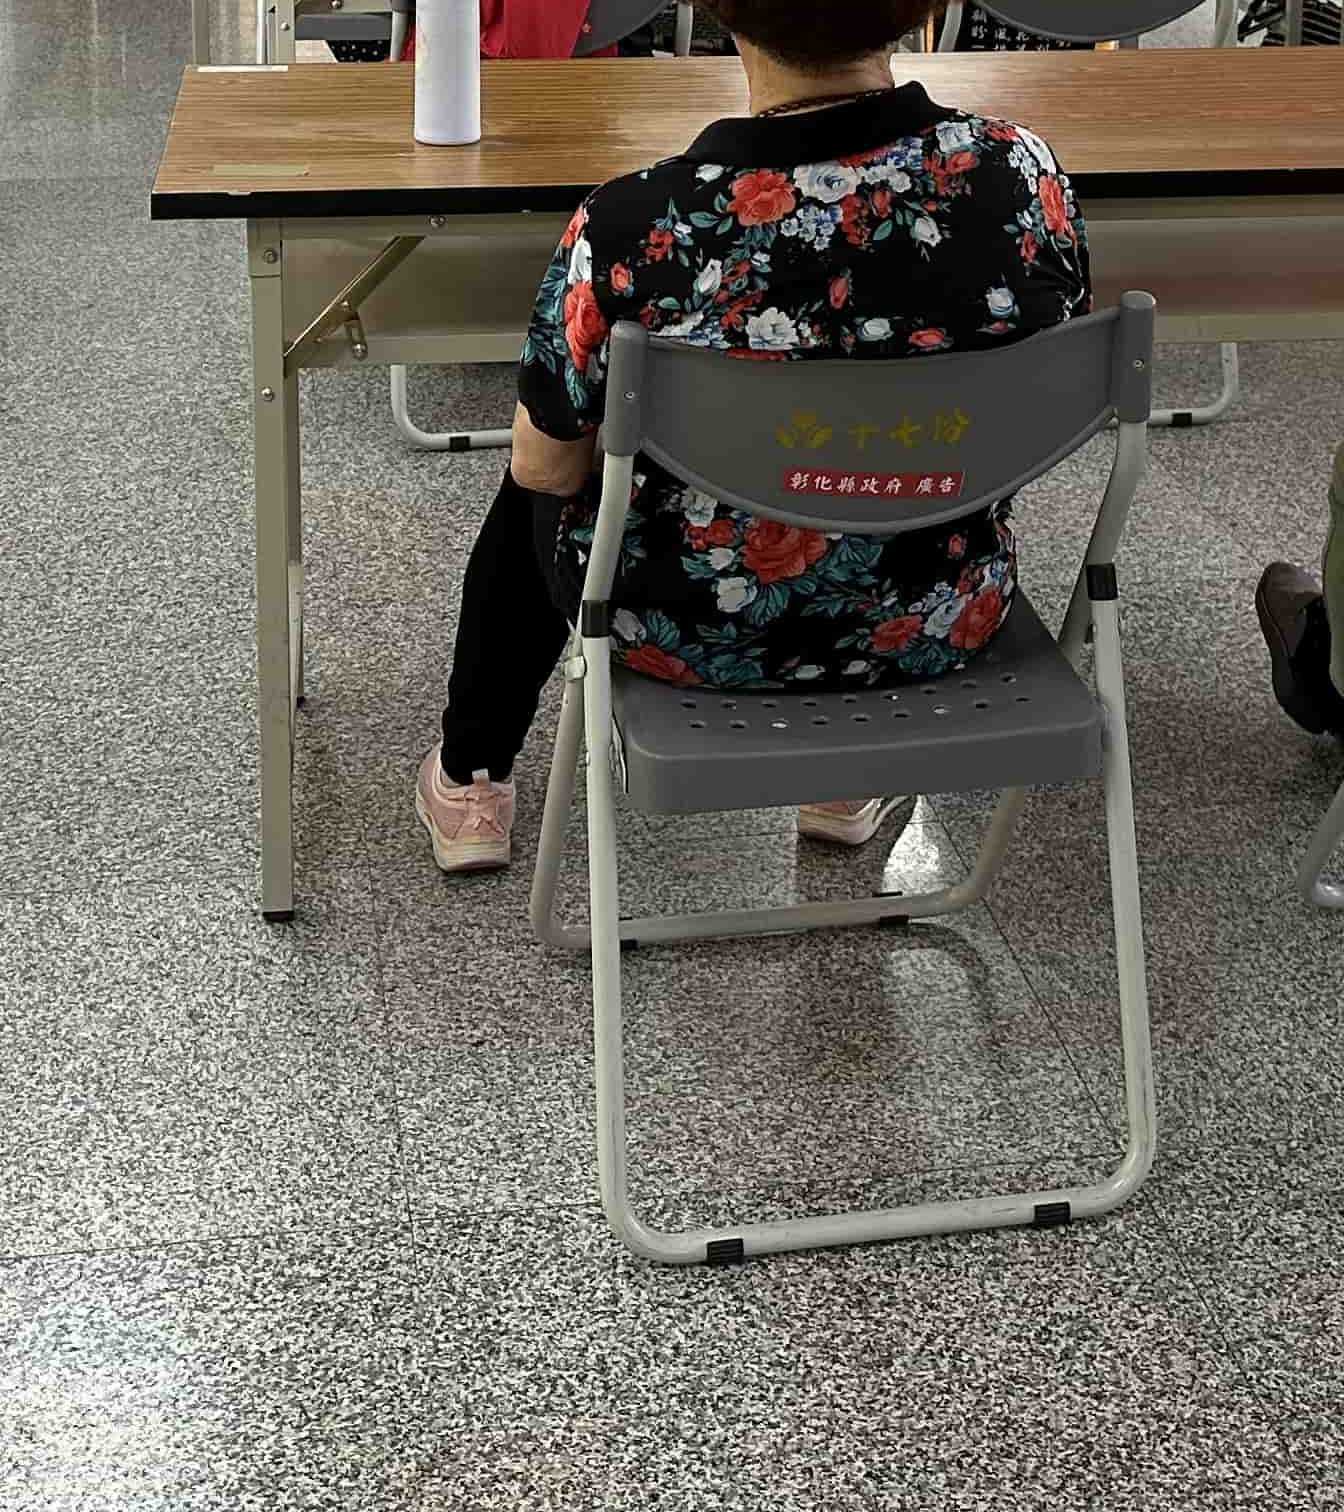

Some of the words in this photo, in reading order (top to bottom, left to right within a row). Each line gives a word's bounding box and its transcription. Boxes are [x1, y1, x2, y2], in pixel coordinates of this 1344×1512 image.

[790, 472, 903, 494] 彰化縣政府
